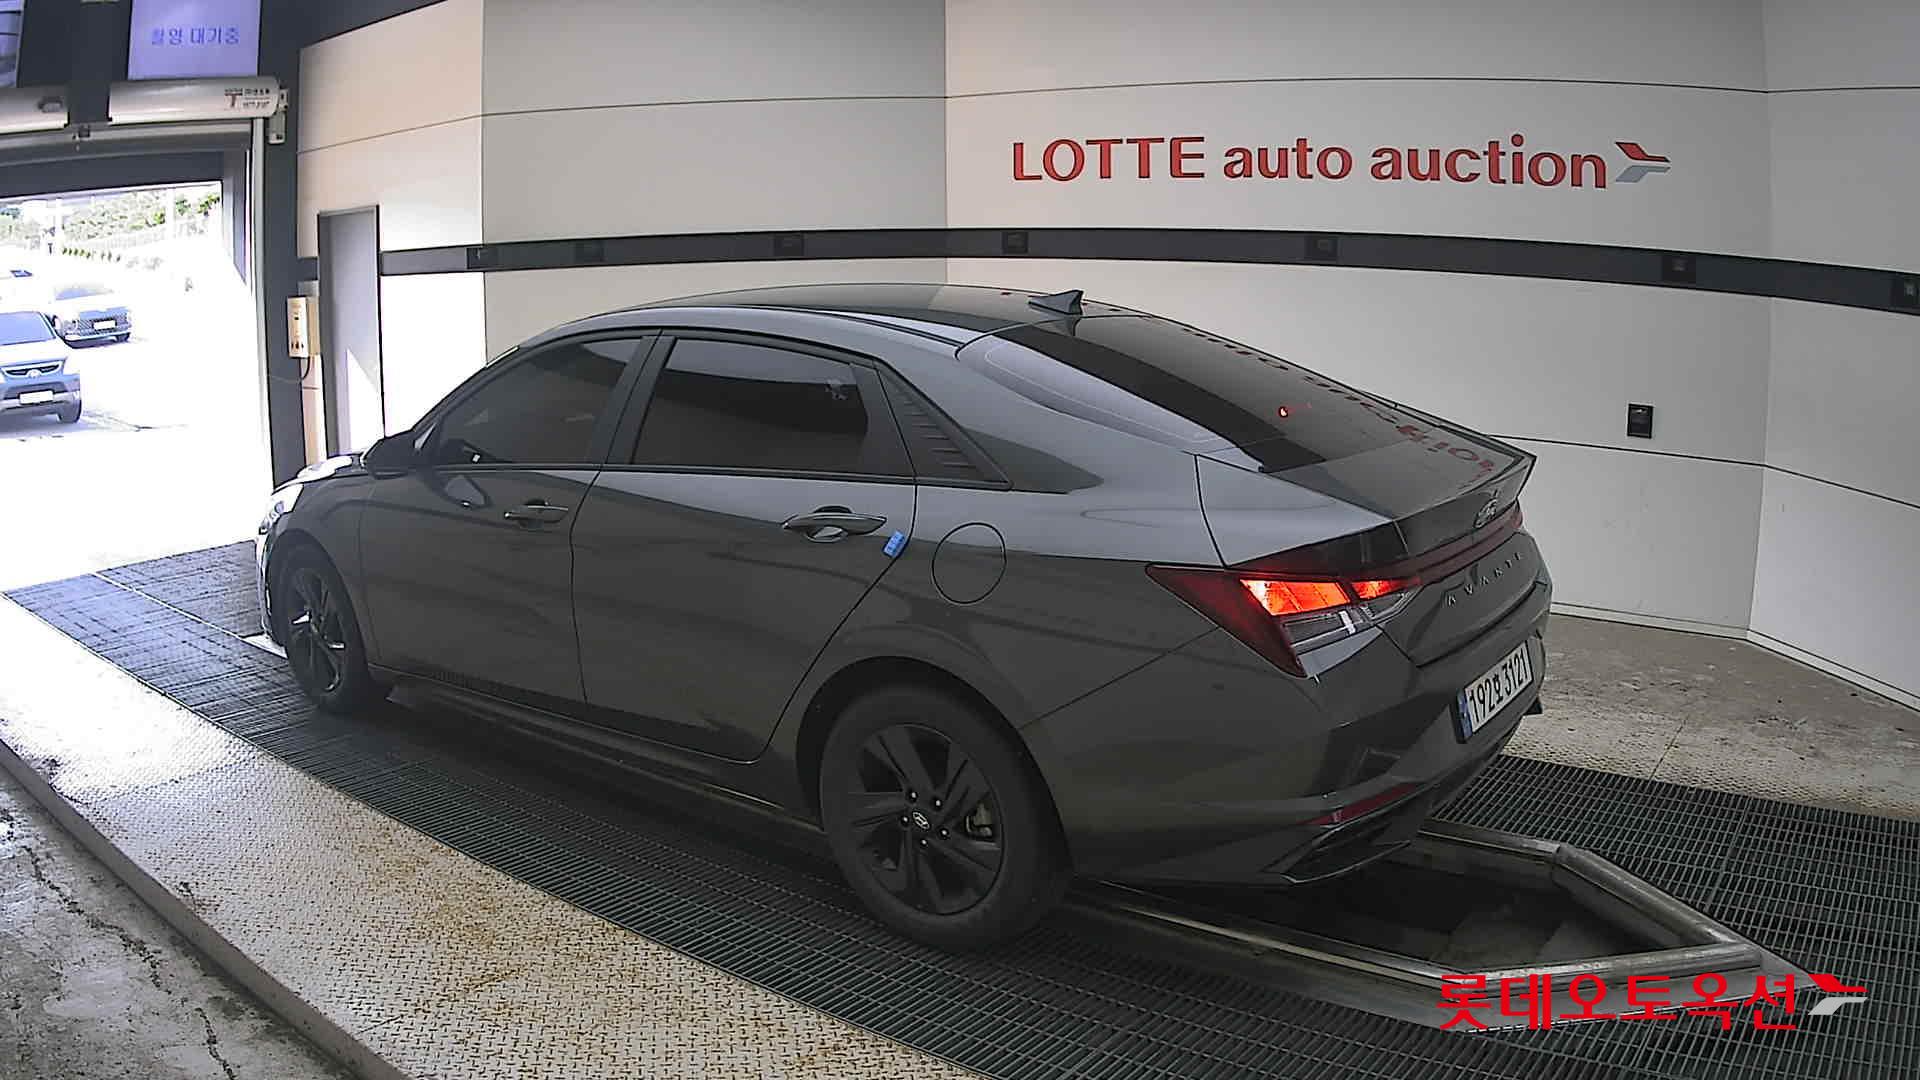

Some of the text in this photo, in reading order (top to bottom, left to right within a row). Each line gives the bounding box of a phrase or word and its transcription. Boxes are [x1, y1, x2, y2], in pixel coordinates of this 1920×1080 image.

[190, 25, 240, 45] 대기중
[1012, 133, 1607, 190] LOTTE auto auction
[1502, 647, 1528, 696] 3121
